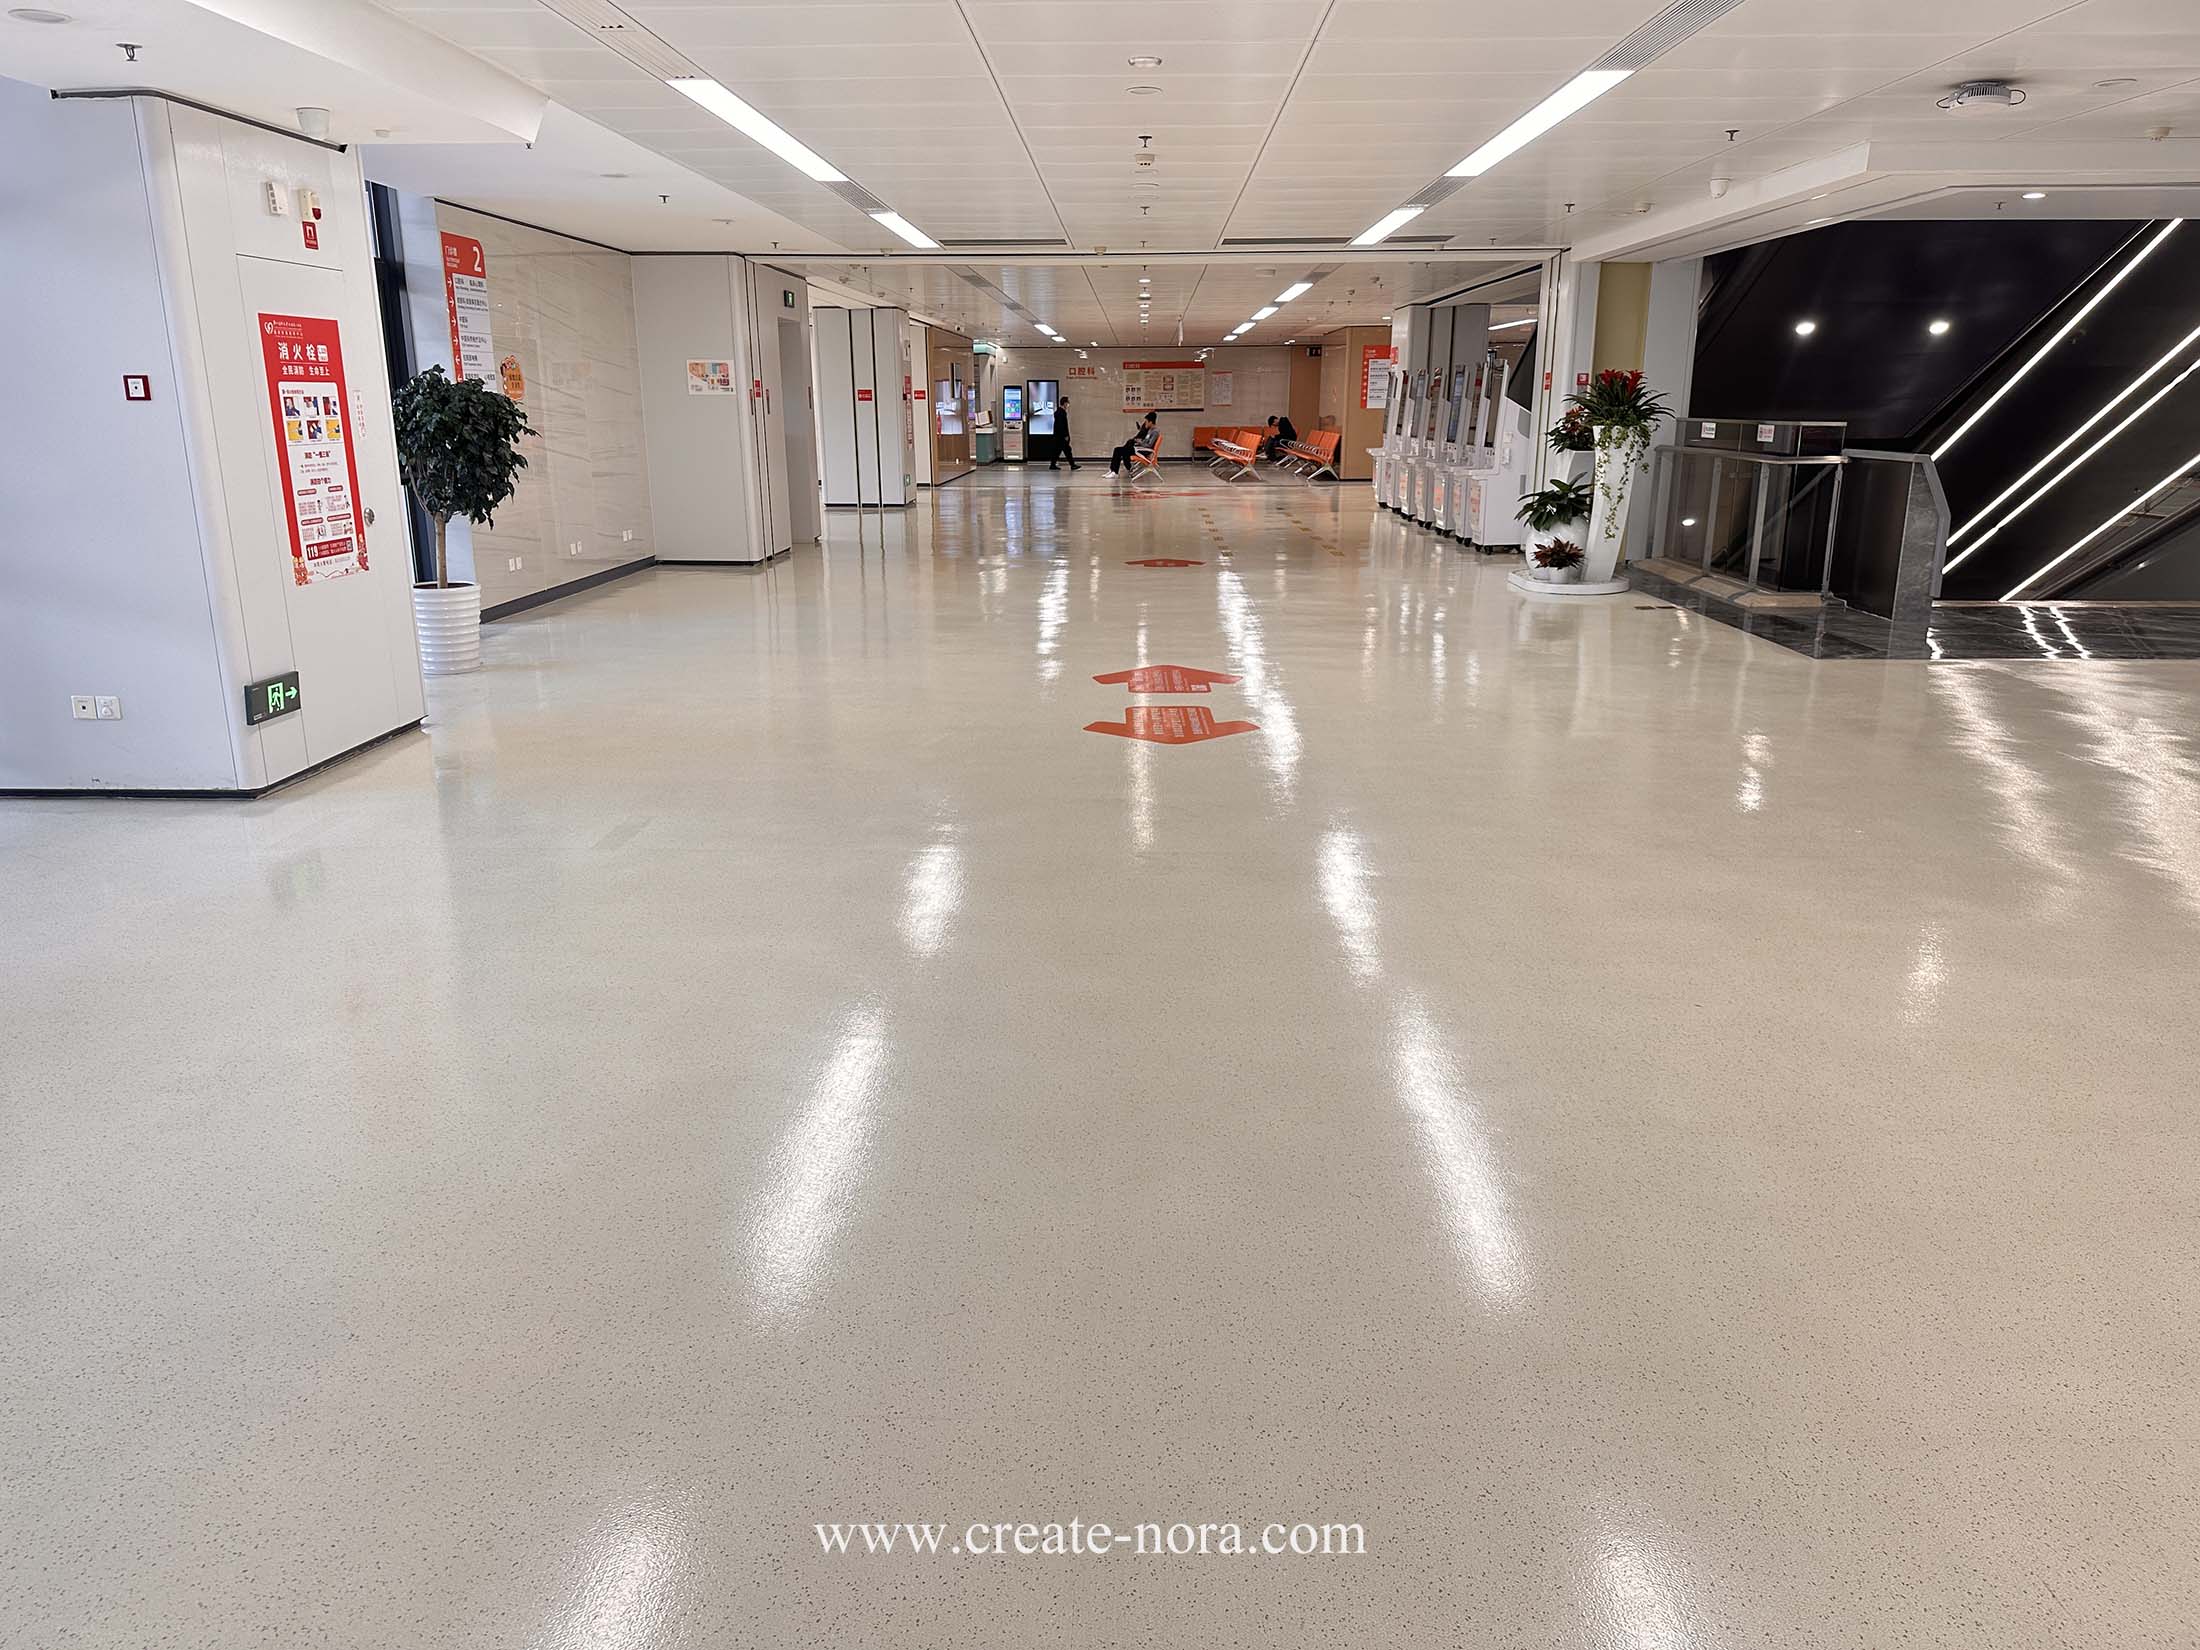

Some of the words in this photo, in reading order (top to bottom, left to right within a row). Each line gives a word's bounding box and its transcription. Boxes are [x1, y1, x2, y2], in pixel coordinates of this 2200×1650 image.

[472, 246, 482, 272] 2
[278, 342, 317, 361] 消火栓
[282, 365, 304, 376] 全民消防
[308, 365, 330, 376] 生命至上
[1069, 367, 1095, 376] 口腔科
[307, 545, 319, 558] 119
